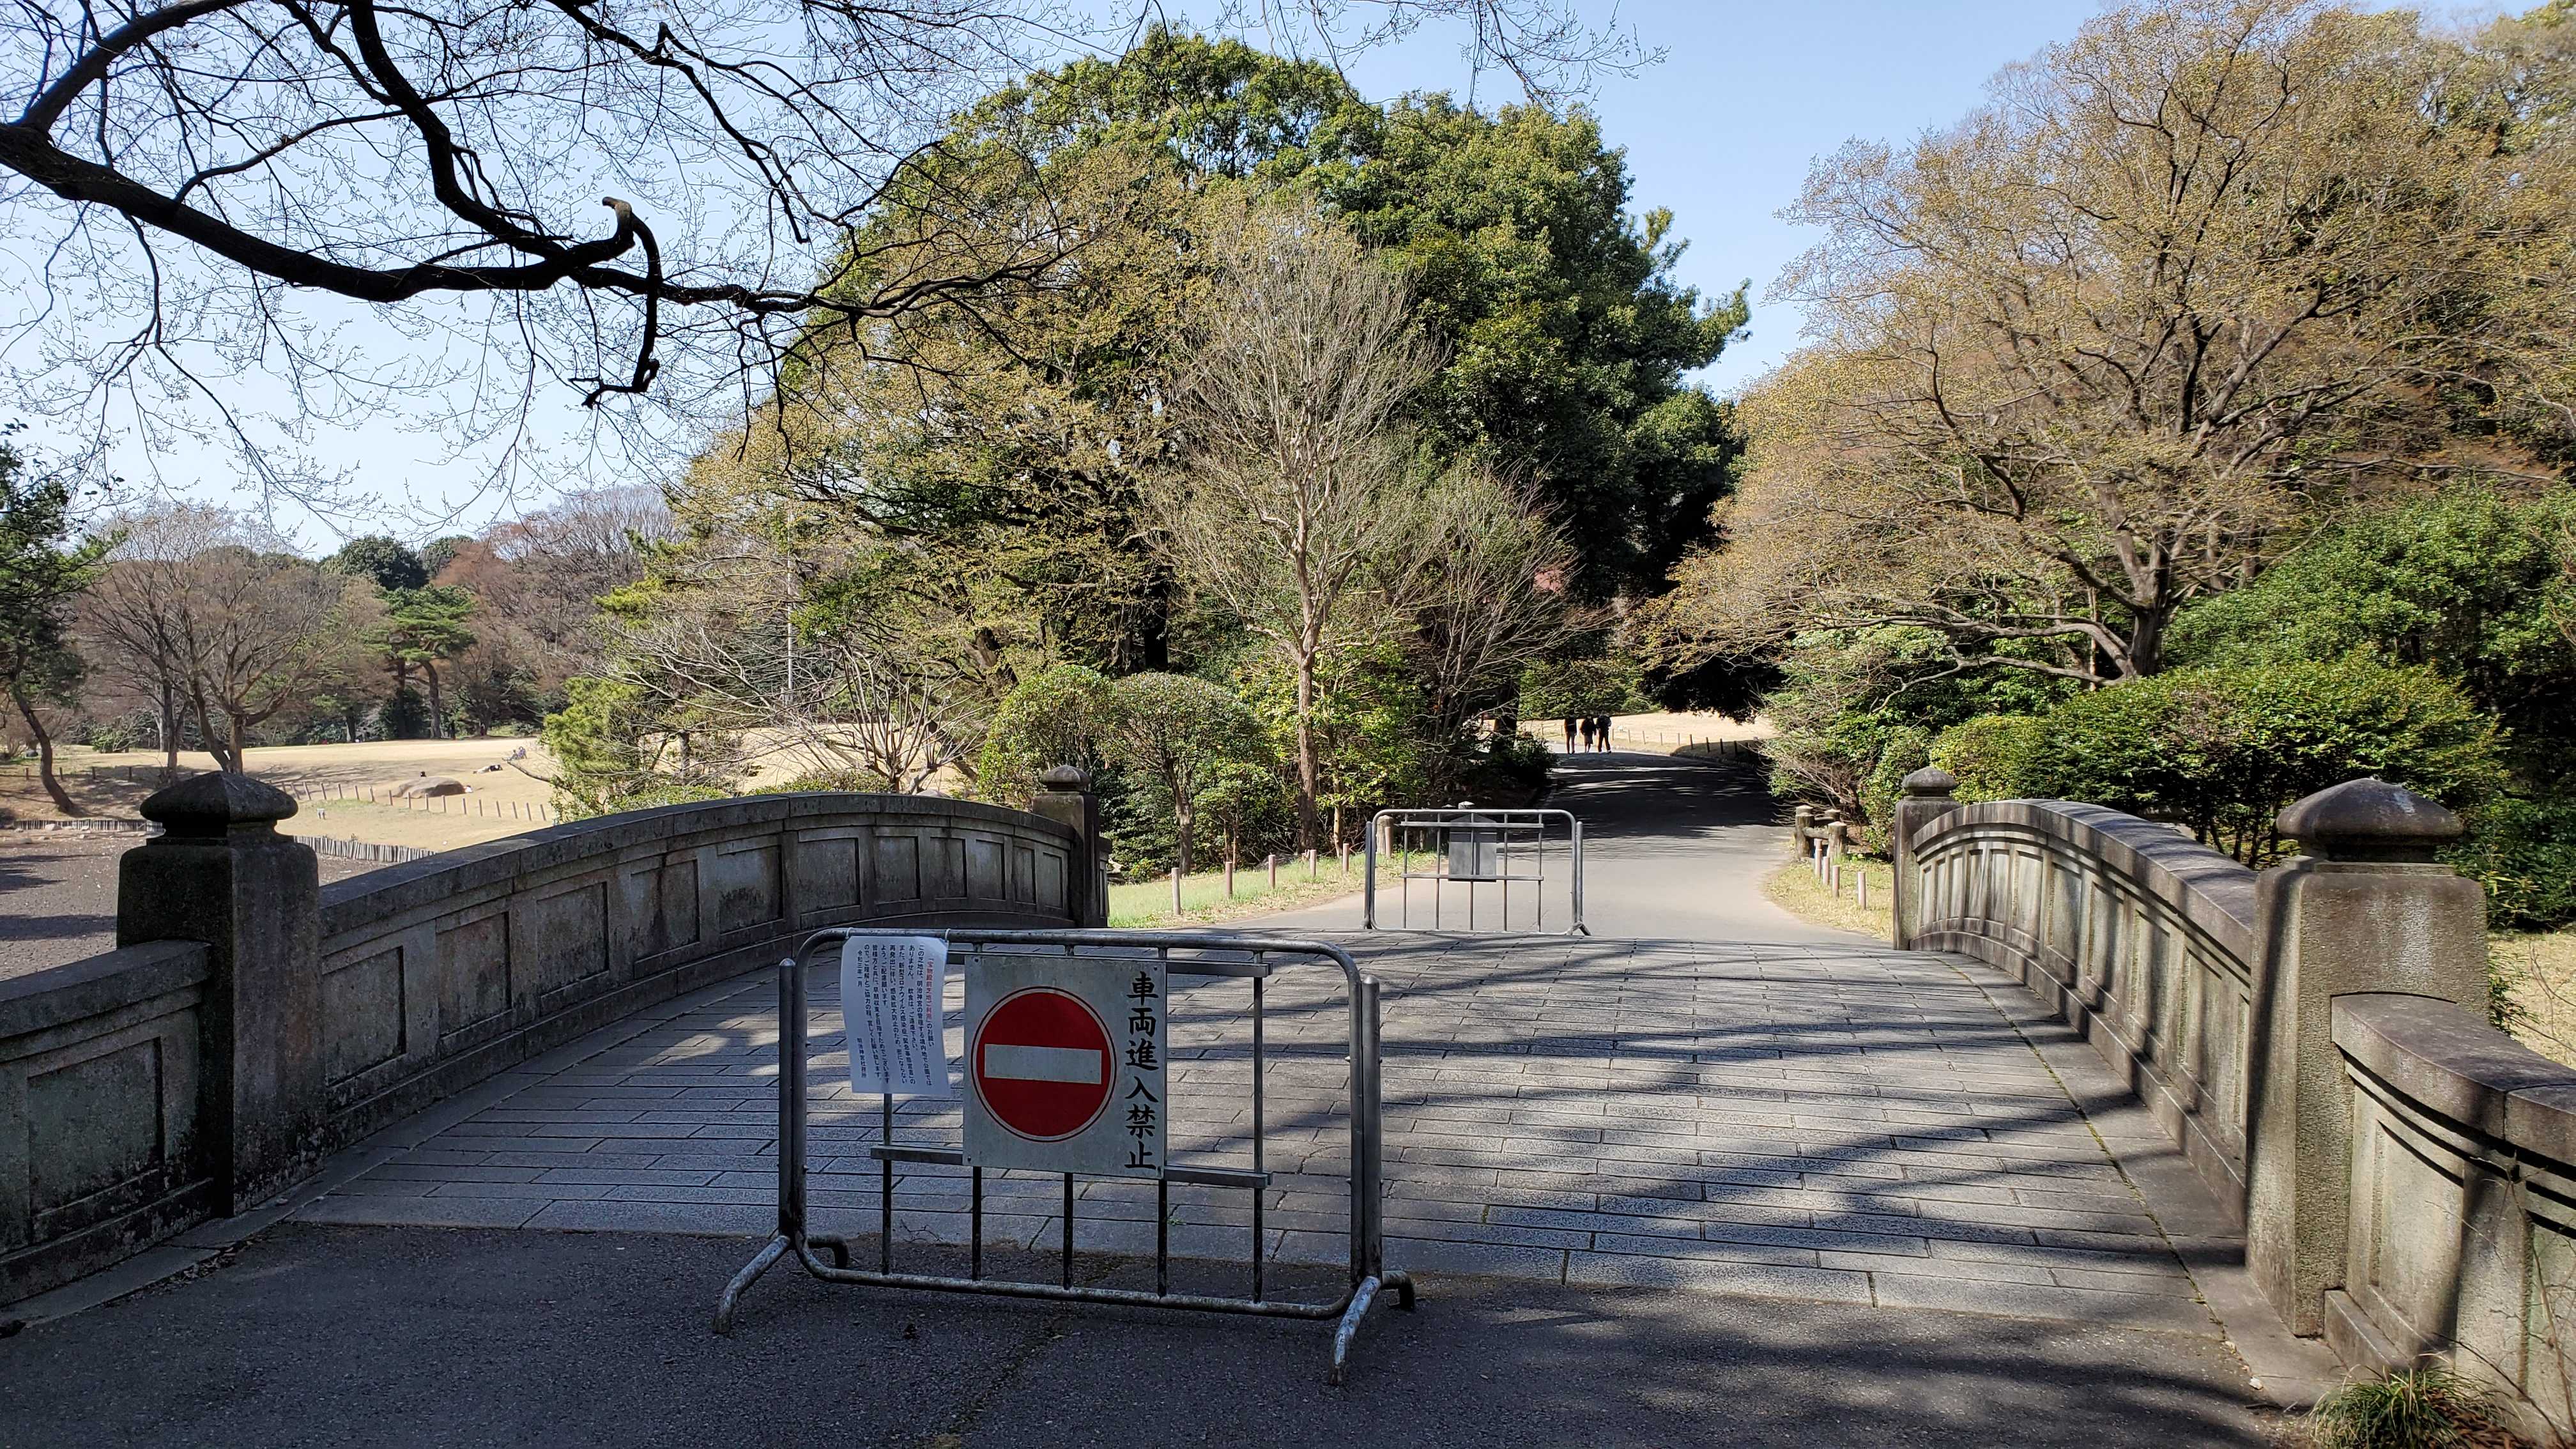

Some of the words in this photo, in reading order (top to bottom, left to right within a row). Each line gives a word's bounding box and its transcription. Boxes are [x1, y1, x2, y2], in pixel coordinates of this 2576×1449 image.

[1124, 970, 1159, 1169] 車両進入禁止
